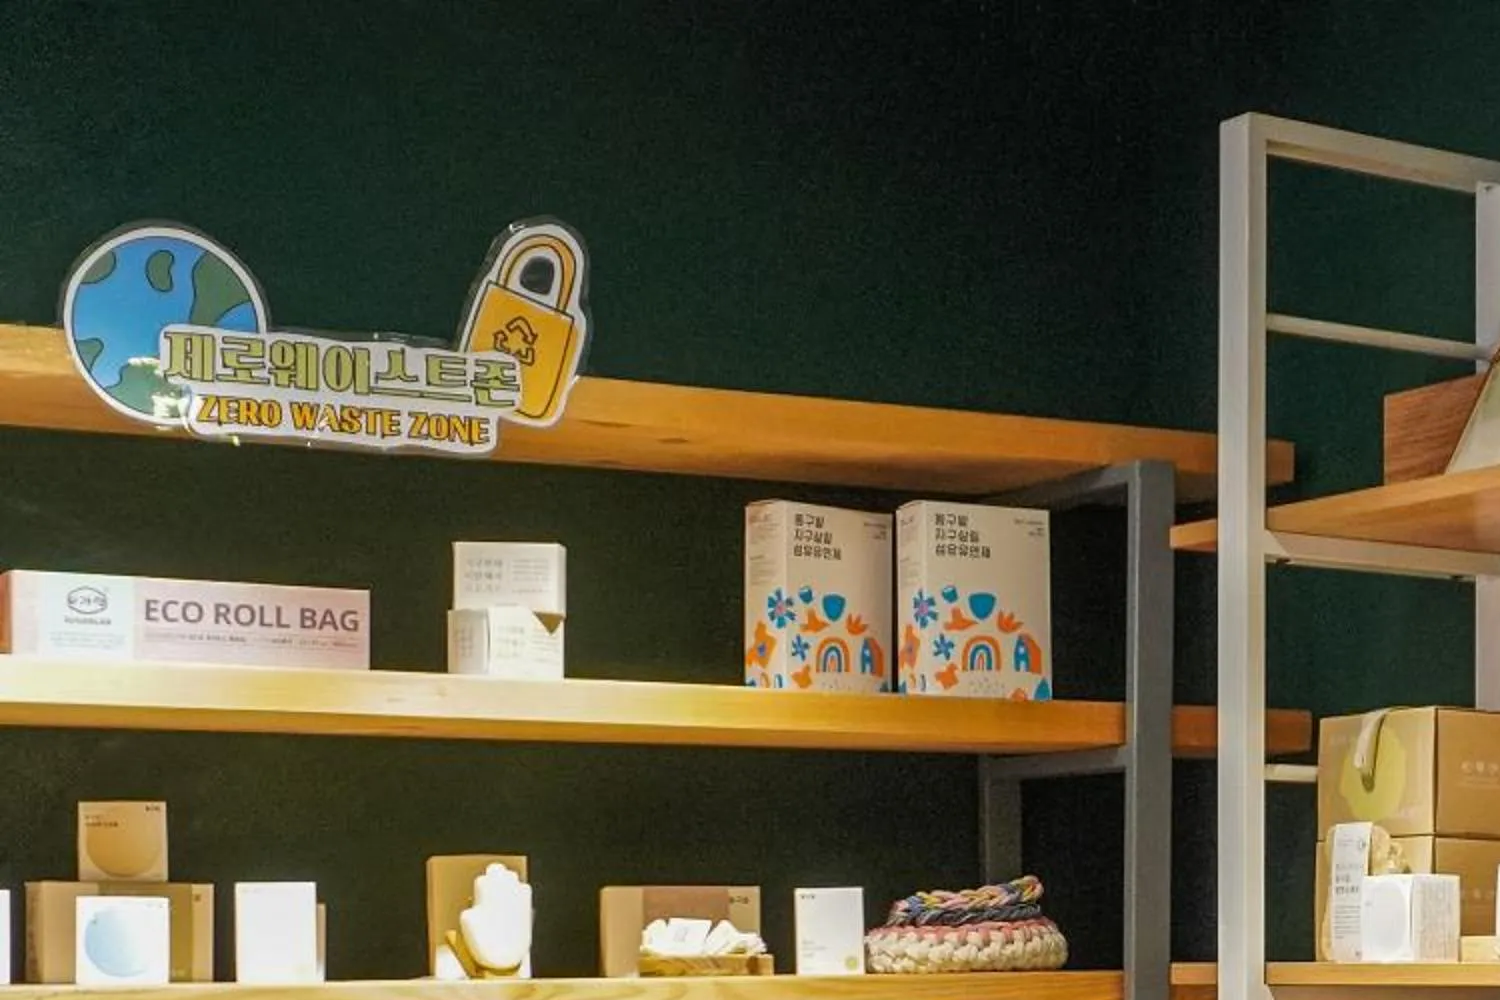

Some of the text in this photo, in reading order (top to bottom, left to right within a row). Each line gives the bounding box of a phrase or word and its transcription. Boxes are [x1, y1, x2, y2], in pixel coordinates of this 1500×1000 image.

[164, 331, 521, 408] 제로웨이스트존
[197, 394, 490, 446] ZERO WASTE ZONE
[144, 599, 360, 633] ECO ROLL BAG
